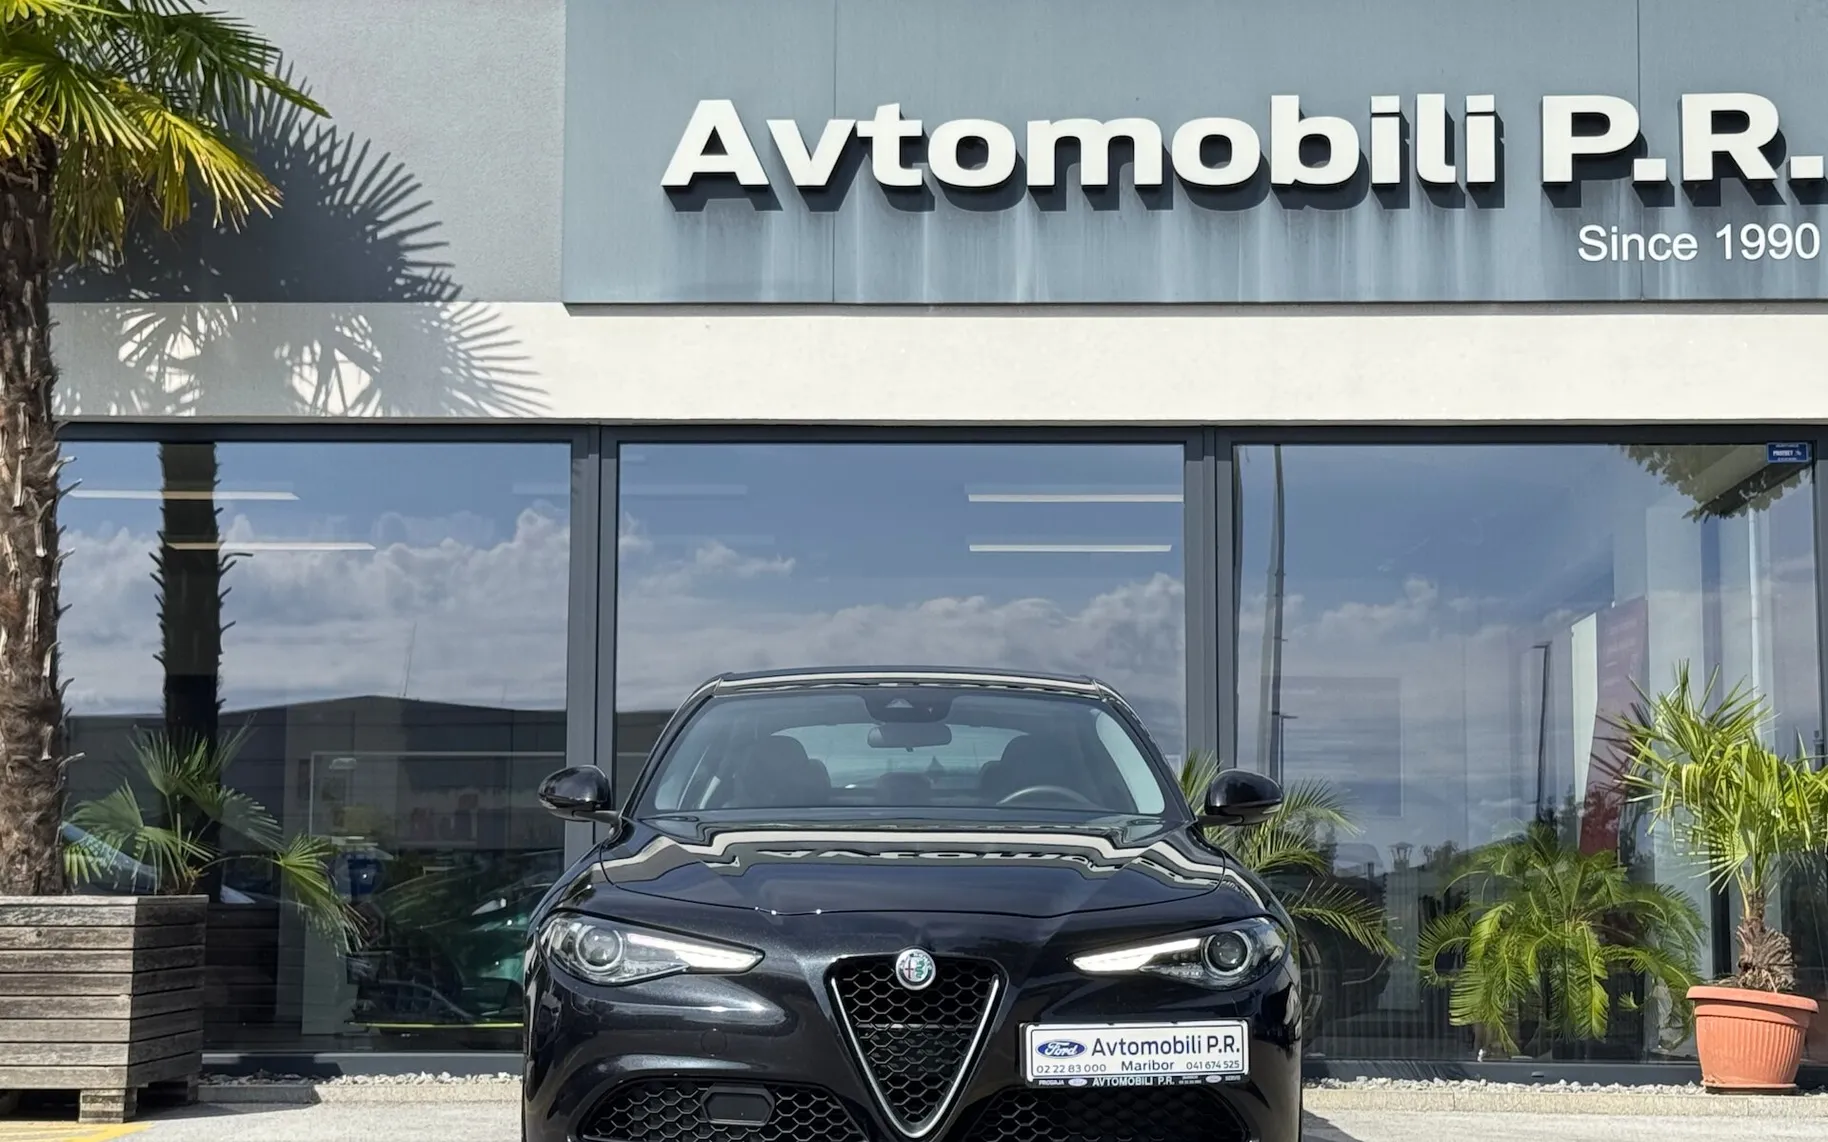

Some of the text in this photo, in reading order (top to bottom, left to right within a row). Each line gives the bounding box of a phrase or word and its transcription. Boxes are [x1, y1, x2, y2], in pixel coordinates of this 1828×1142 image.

[661, 92, 1825, 188] Avtomobili P.R.
[1577, 221, 1821, 262] Since 1990
[1044, 1041, 1079, 1056] Ford
[1091, 1035, 1240, 1056] Avtomobili P.R.
[1036, 1060, 1240, 1073] 02 22 83 000 Maribor 041 674 525
[1092, 1076, 1154, 1087] AVTOMOBILI
[1158, 1076, 1175, 1086] P.R.
